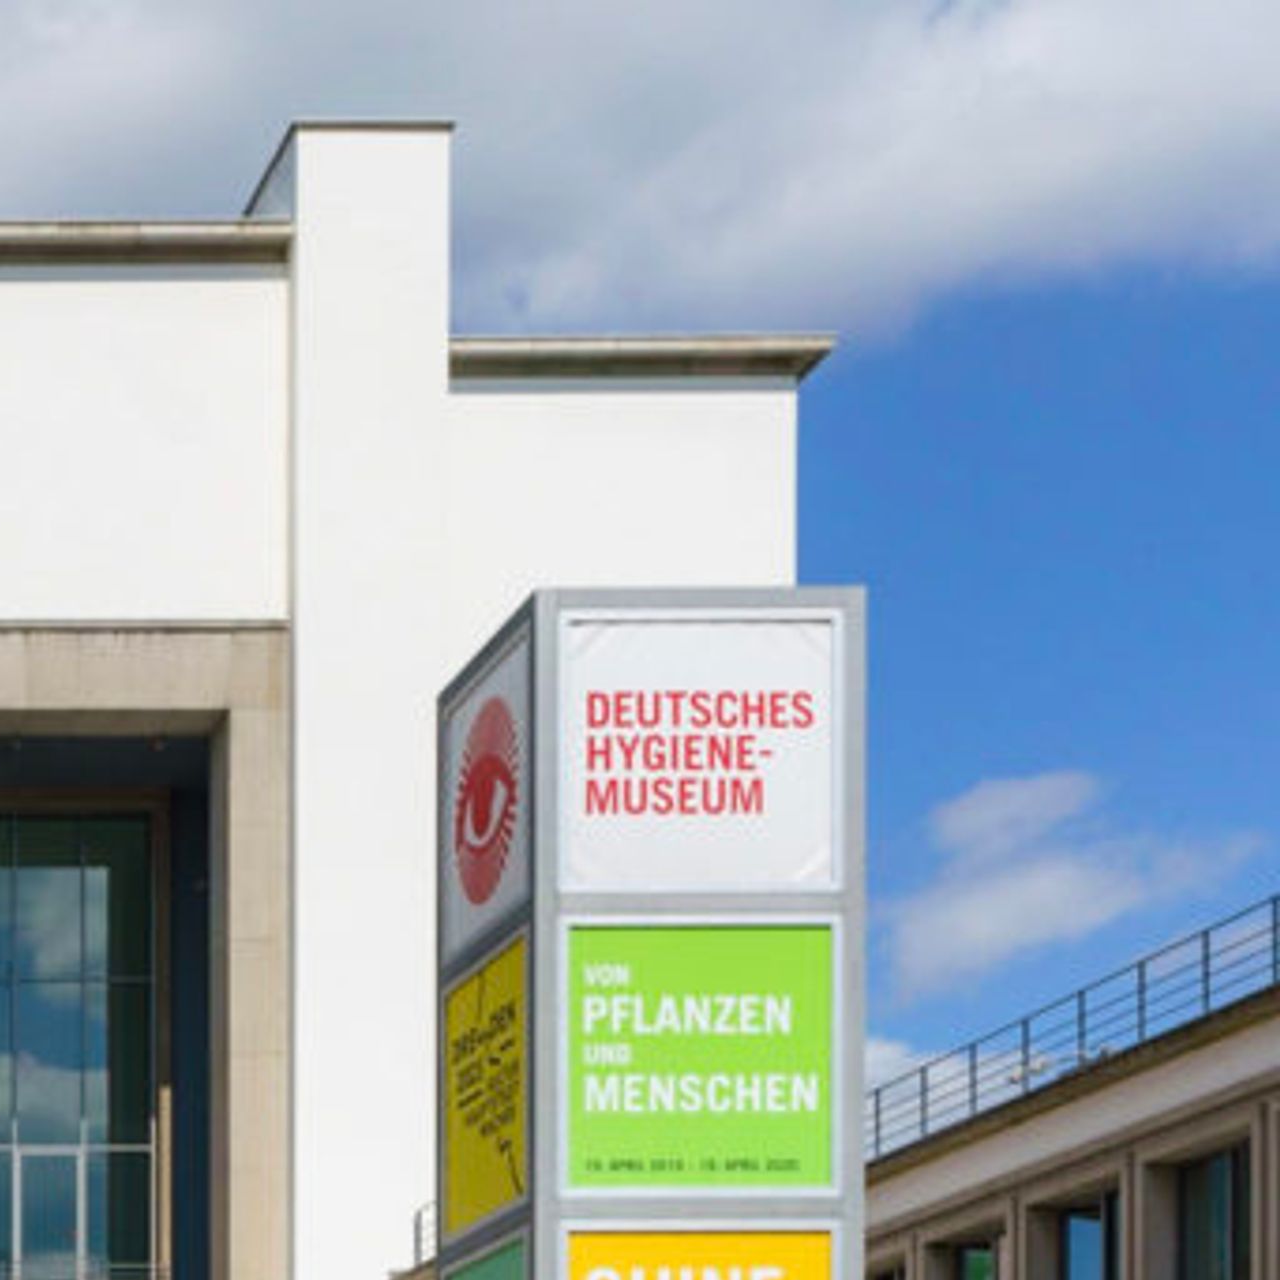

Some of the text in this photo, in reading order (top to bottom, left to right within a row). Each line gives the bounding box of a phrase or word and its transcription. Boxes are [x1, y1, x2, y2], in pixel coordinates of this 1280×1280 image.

[585, 691, 815, 729] DEUTSCHES
[585, 734, 773, 772] HYGIENE-
[585, 777, 764, 816] MUSEUM
[583, 964, 631, 987] VON
[582, 994, 793, 1035] PFLANZEN
[583, 1043, 632, 1066] UND
[583, 1073, 819, 1113] MENSCHEN
